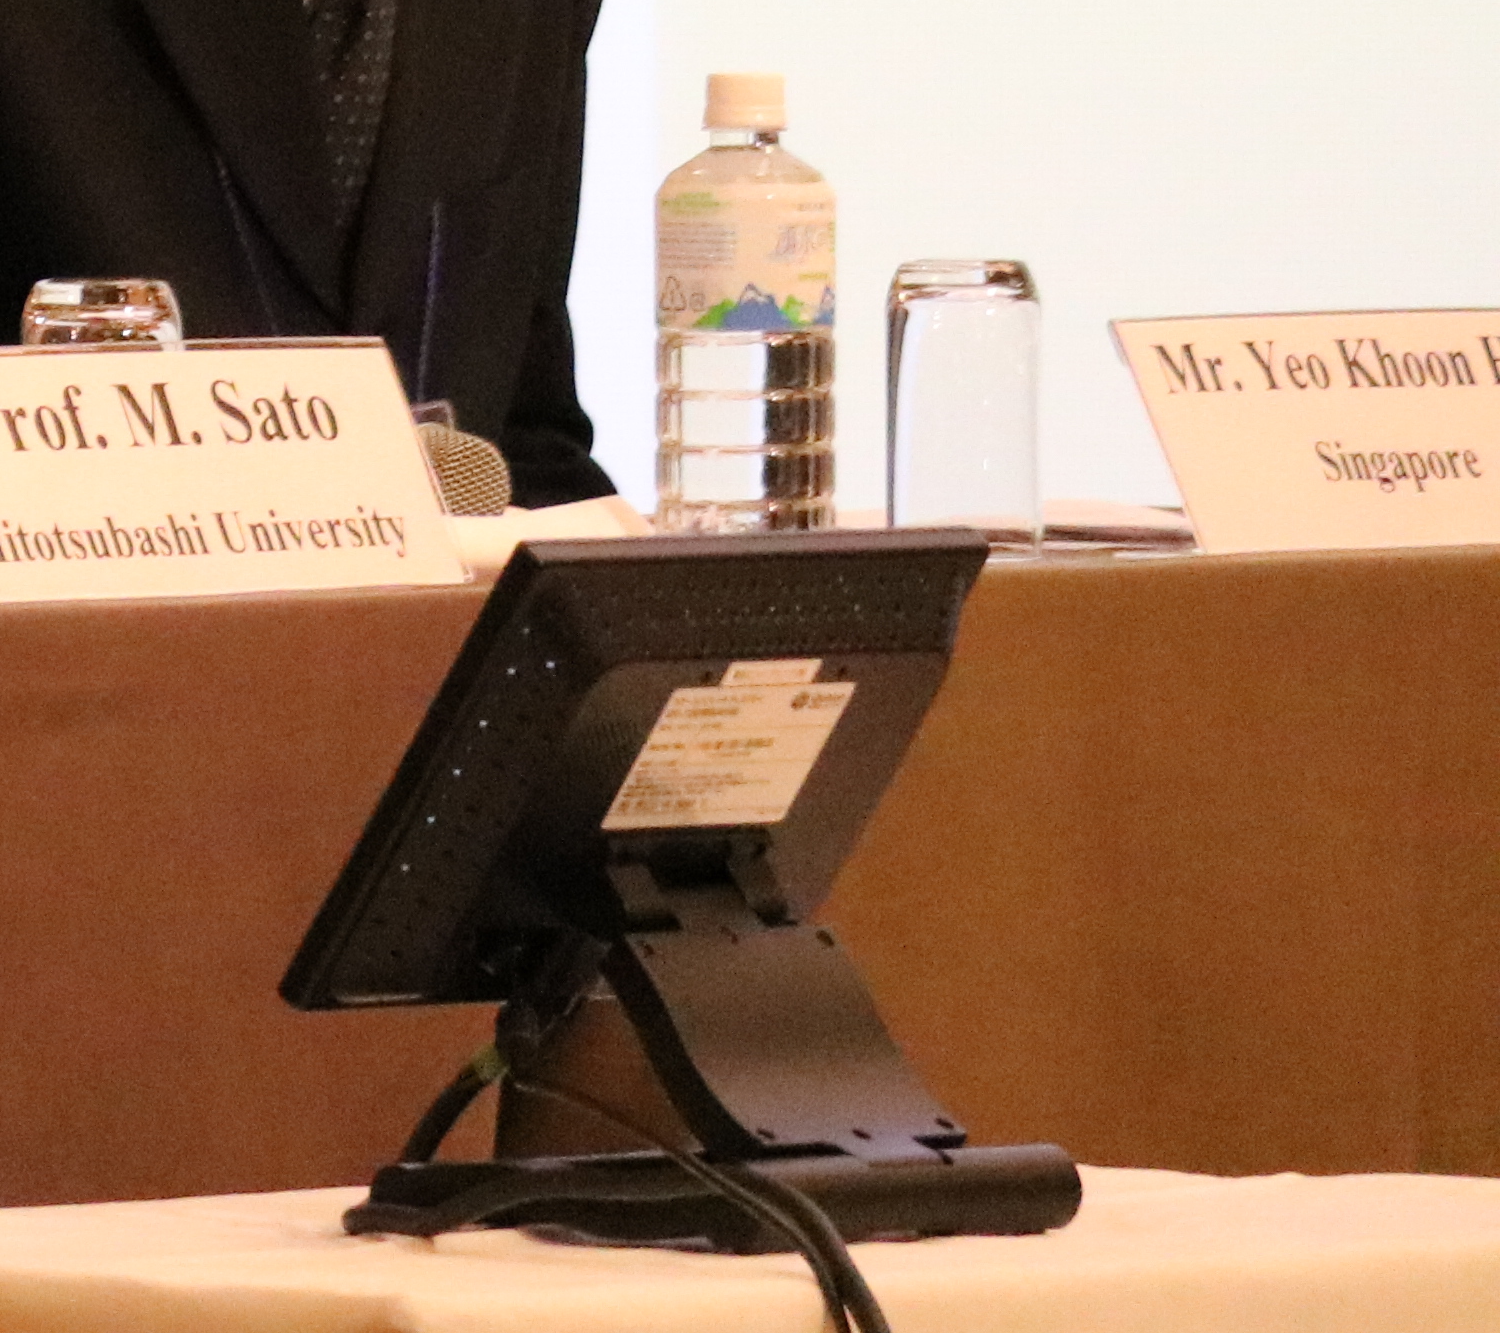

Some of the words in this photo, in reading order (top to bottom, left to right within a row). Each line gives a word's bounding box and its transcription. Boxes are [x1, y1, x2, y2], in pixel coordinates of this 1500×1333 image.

[1151, 342, 1243, 394] Mr.
[1242, 340, 1332, 391] Yeo
[1334, 337, 1477, 389] Khoon
[113, 382, 203, 448] M.
[210, 379, 341, 446] Sato
[1315, 440, 1484, 494] Singapore
[213, 504, 408, 560] University
